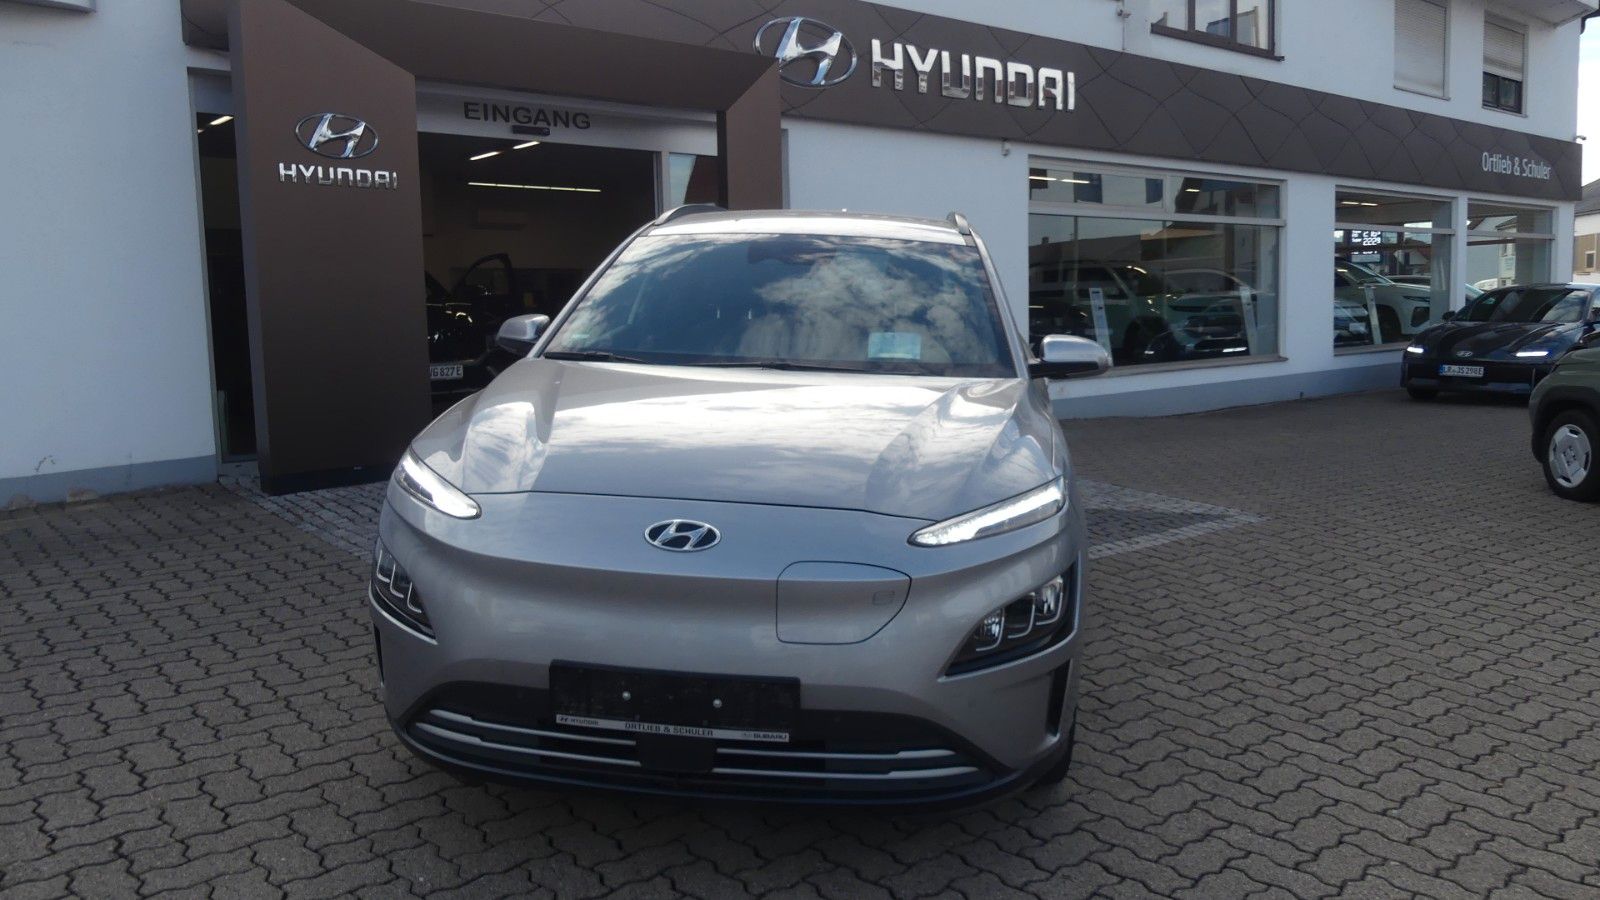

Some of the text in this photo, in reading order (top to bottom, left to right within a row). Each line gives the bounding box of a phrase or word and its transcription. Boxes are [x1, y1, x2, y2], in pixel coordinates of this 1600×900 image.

[871, 38, 1076, 111] HYUNDAI
[463, 101, 592, 130] EINGANG
[278, 162, 398, 190] HYUNDAI
[1481, 151, 1552, 180] Ortlieb & Schuler
[624, 722, 714, 737] ORTLIEB & SCHULER
[753, 733, 788, 741] SUBARU
